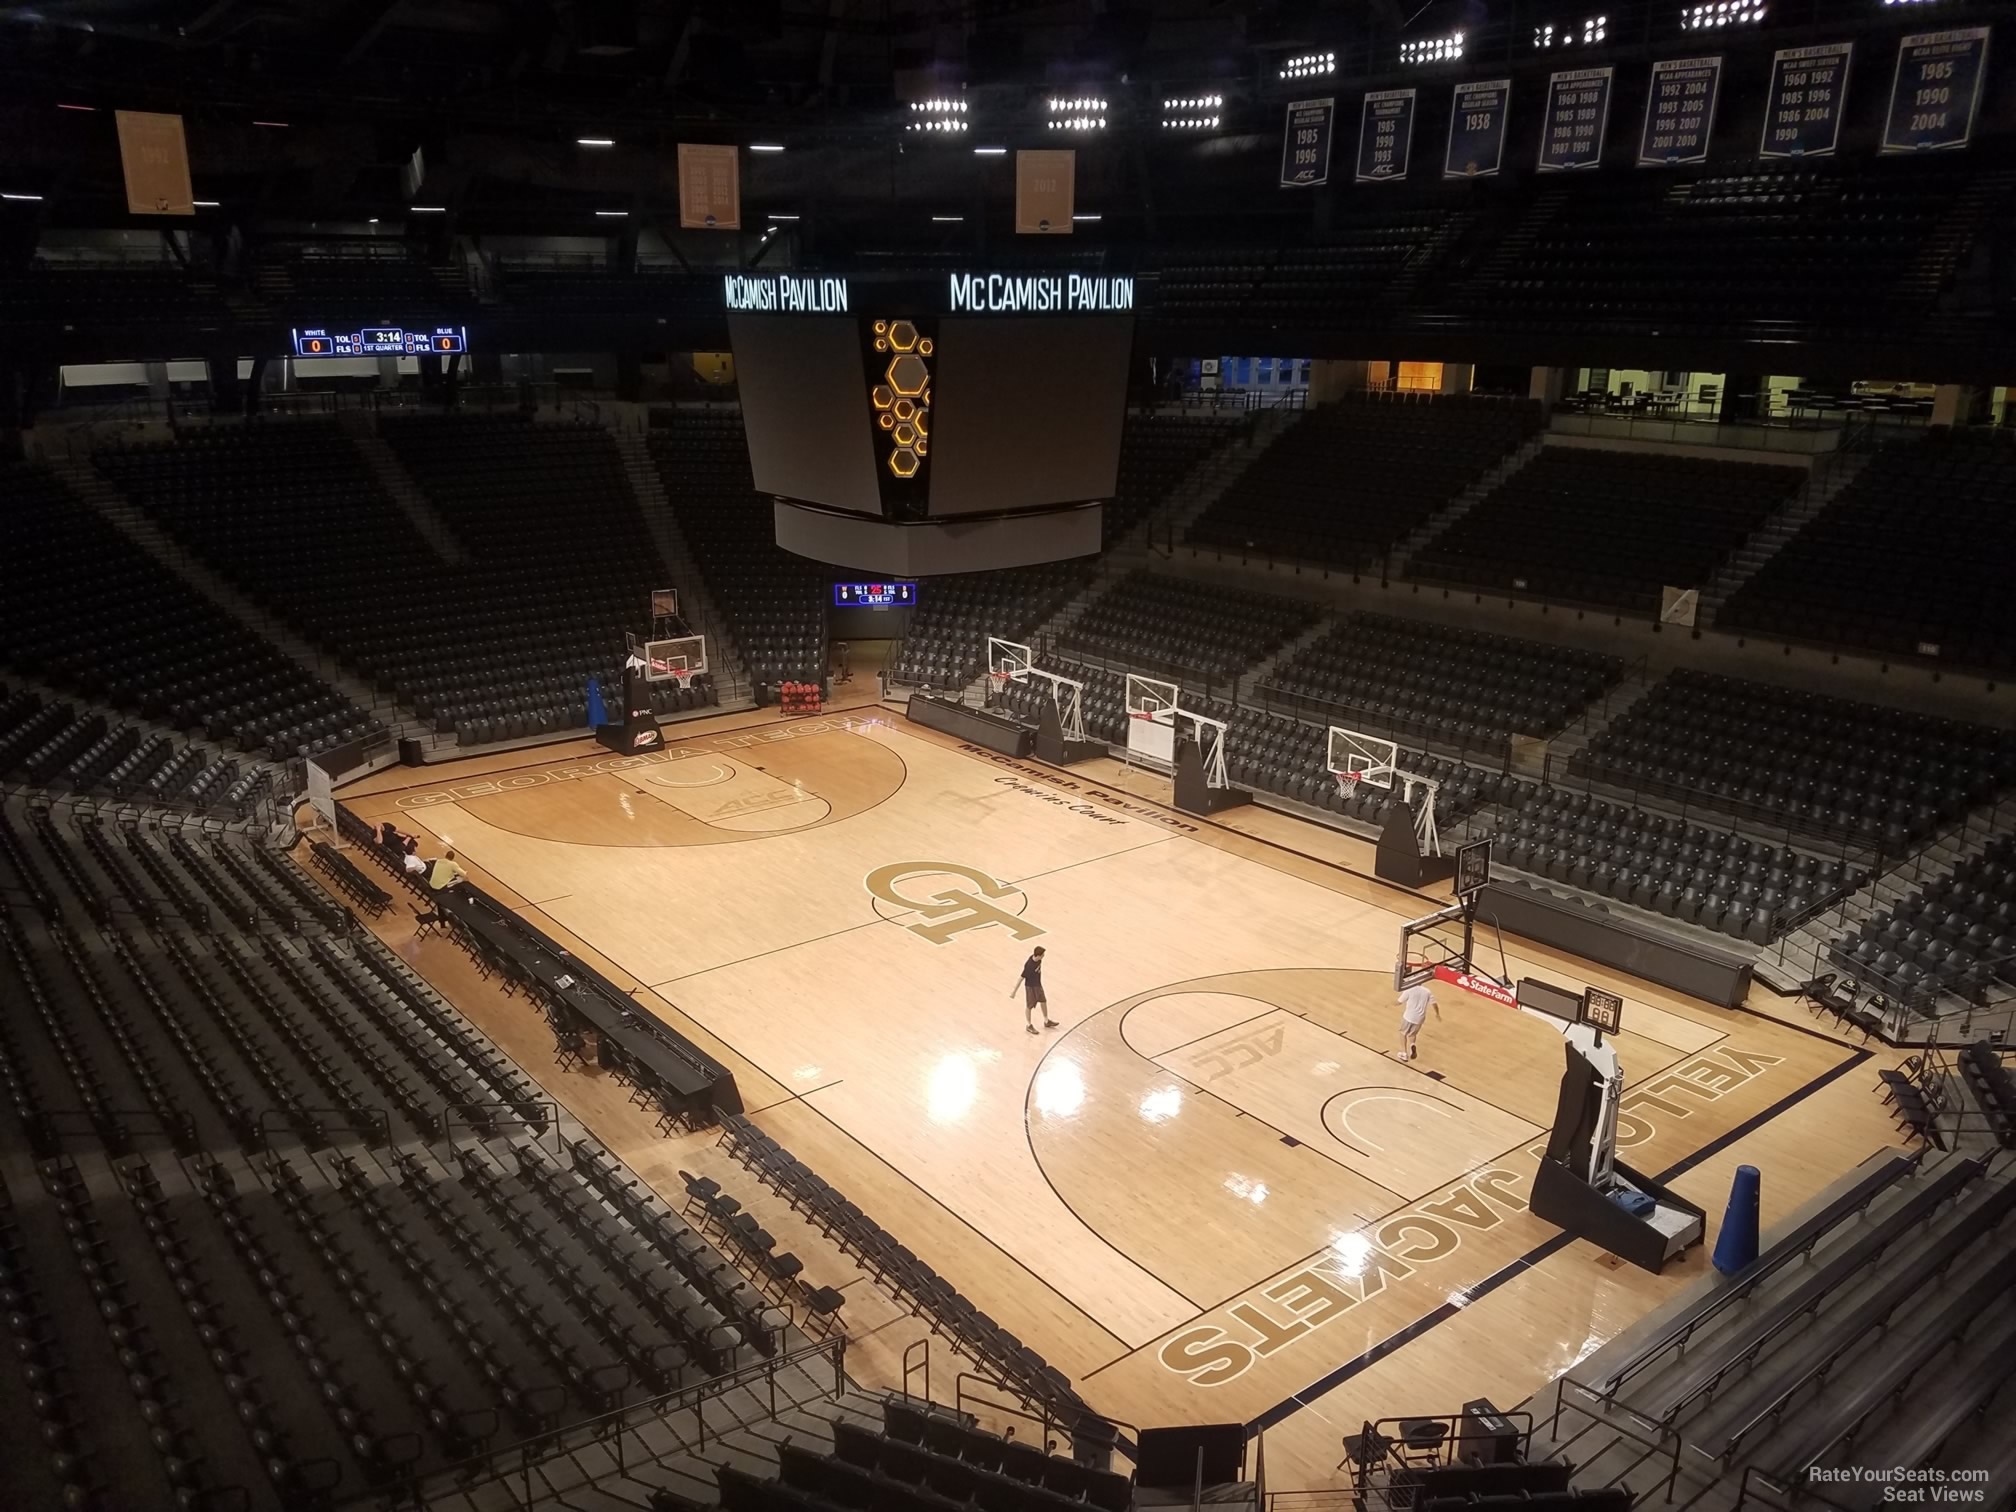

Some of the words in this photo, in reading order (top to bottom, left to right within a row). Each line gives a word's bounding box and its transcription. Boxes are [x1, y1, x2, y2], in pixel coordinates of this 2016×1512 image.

[1784, 72, 1807, 87] 1960
[1811, 70, 1834, 84] 1992
[1921, 61, 1954, 81] 1985
[1661, 84, 1681, 97] 1992
[1684, 82, 1708, 95] 2004
[1781, 91, 1804, 105] 1985
[1808, 88, 1831, 103] 1996
[1916, 87, 1949, 106] 1990
[1558, 93, 1577, 106] 1960
[1658, 101, 1678, 114] 1993
[1681, 99, 1704, 113] 2005
[1466, 113, 1490, 131] 1938
[1778, 110, 1801, 123] 1986
[1804, 107, 1830, 121] 2004
[1910, 112, 1946, 131] 2004
[1377, 120, 1396, 133] 1985
[1656, 118, 1676, 131] 1996
[1679, 116, 1701, 130] 2007
[1297, 128, 1318, 145] 1985
[1376, 135, 1394, 148] 1990
[1652, 136, 1673, 148] 2001
[1676, 134, 1697, 147] 2010
[1775, 127, 1798, 141] 1990
[1295, 148, 1317, 164] 1996
[1374, 150, 1392, 162] 1993
[1294, 169, 1316, 179] ACC
[1371, 164, 1395, 174] ACC
[780, 274, 848, 312] PAVILION
[1068, 274, 1134, 310] PAVILION
[335, 335, 350, 343] TOL
[376, 332, 401, 343] 3:14
[414, 334, 429, 342] TOL
[441, 338, 451, 350] 0
[311, 340, 321, 352] 0
[336, 345, 351, 353] FLS
[639, 708, 653, 716] PNC
[395, 746, 712, 808] GEORGIA
[713, 715, 871, 748] TECH
[958, 743, 1080, 791] McCamish
[1084, 789, 1200, 833] Pavilion
[1069, 803, 1132, 826] Court
[863, 860, 1049, 947] GT
[1156, 1168, 1531, 1388] JACKETS
